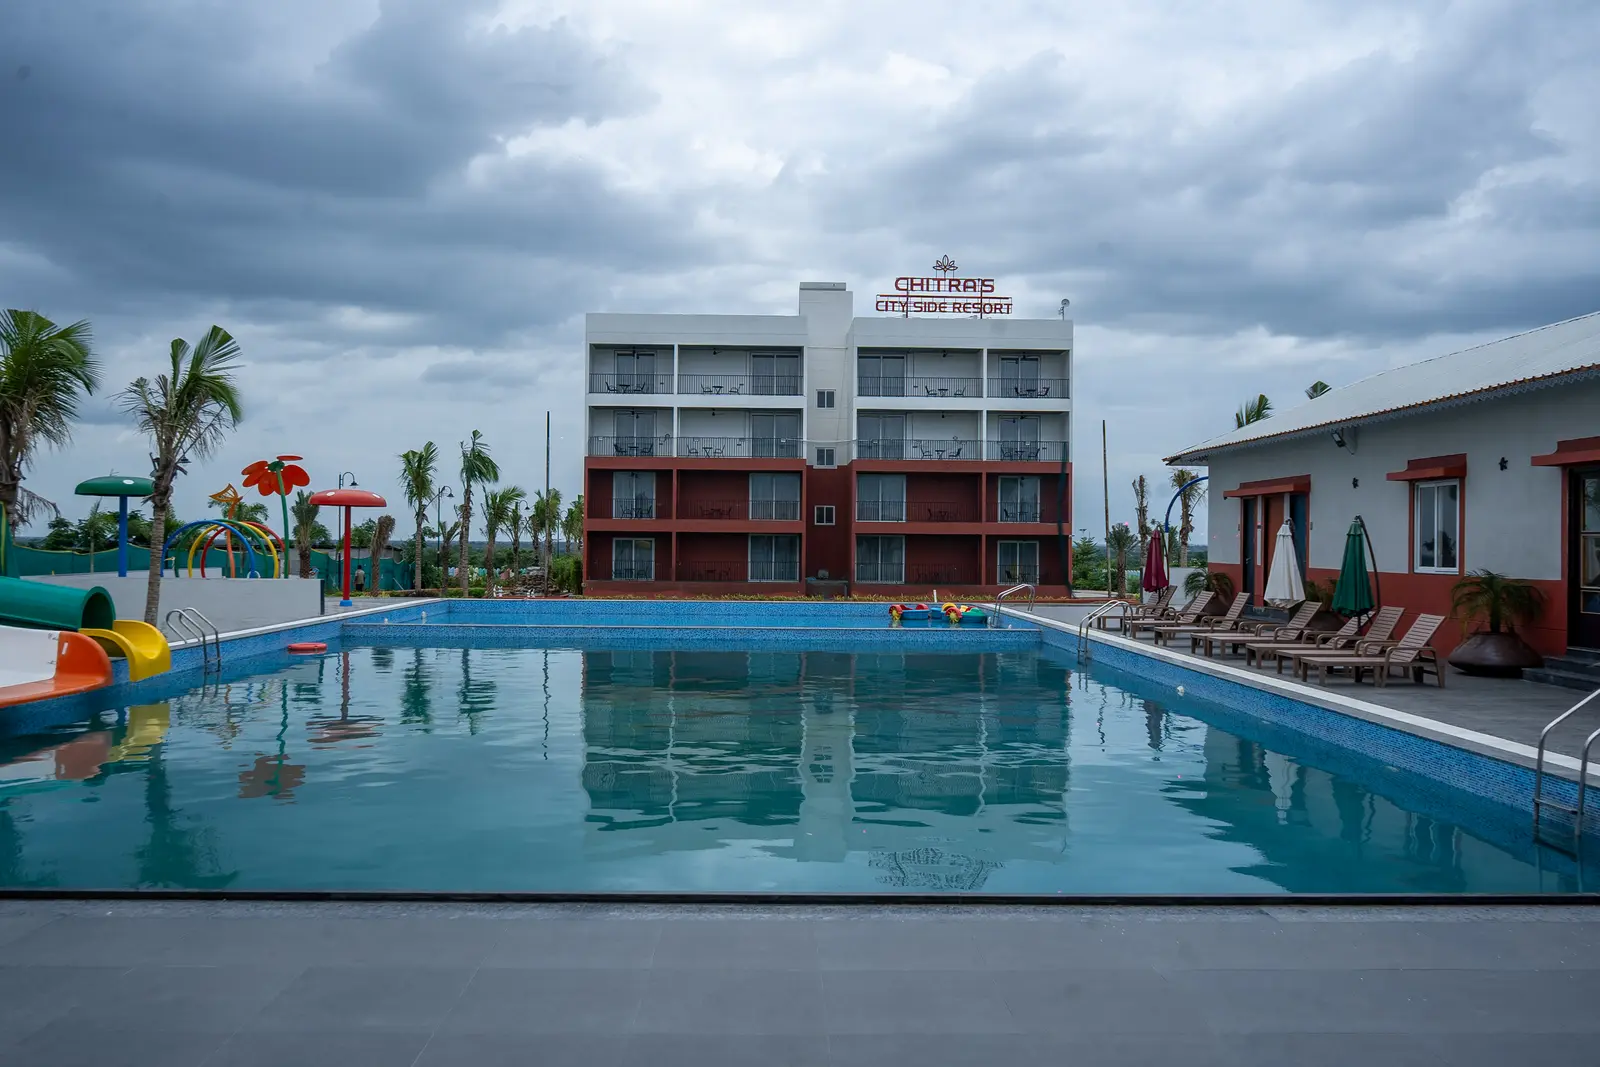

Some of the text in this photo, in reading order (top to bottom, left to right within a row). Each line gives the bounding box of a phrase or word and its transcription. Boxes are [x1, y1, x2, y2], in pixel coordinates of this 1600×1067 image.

[895, 278, 994, 293] CHITRA'S
[876, 301, 1012, 314] CITY SIDE RESORT
